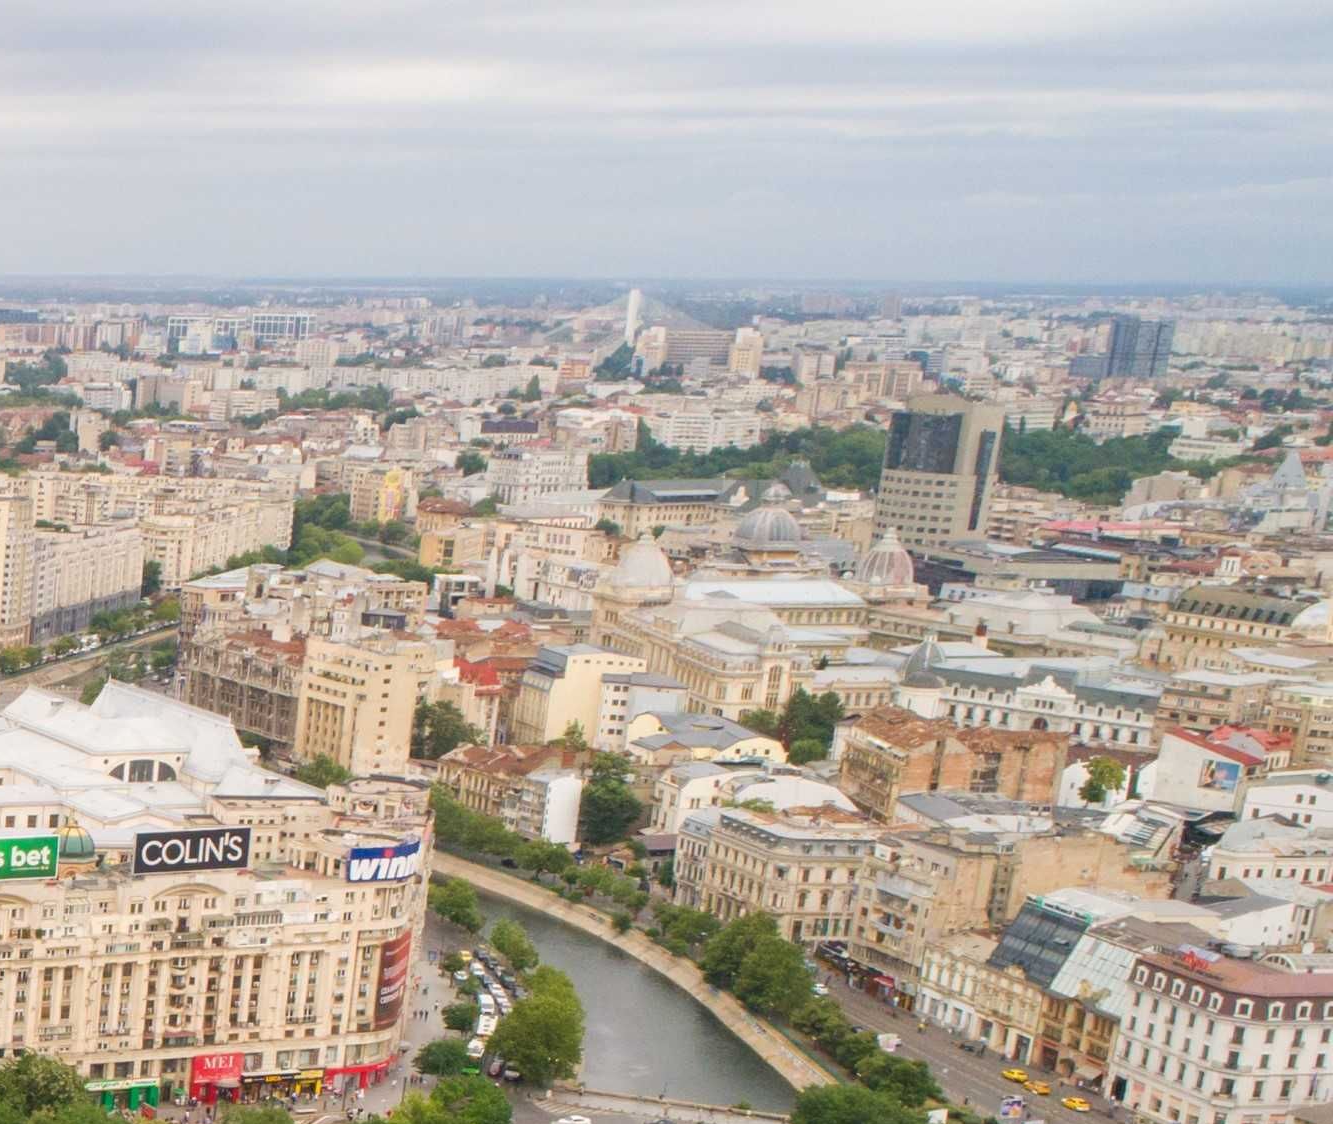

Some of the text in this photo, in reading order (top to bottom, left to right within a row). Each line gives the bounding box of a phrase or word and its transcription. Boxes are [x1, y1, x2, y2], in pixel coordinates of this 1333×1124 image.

[10, 845, 51, 867] bet
[141, 832, 243, 866] COLIN'S
[203, 1054, 234, 1070] MEI
